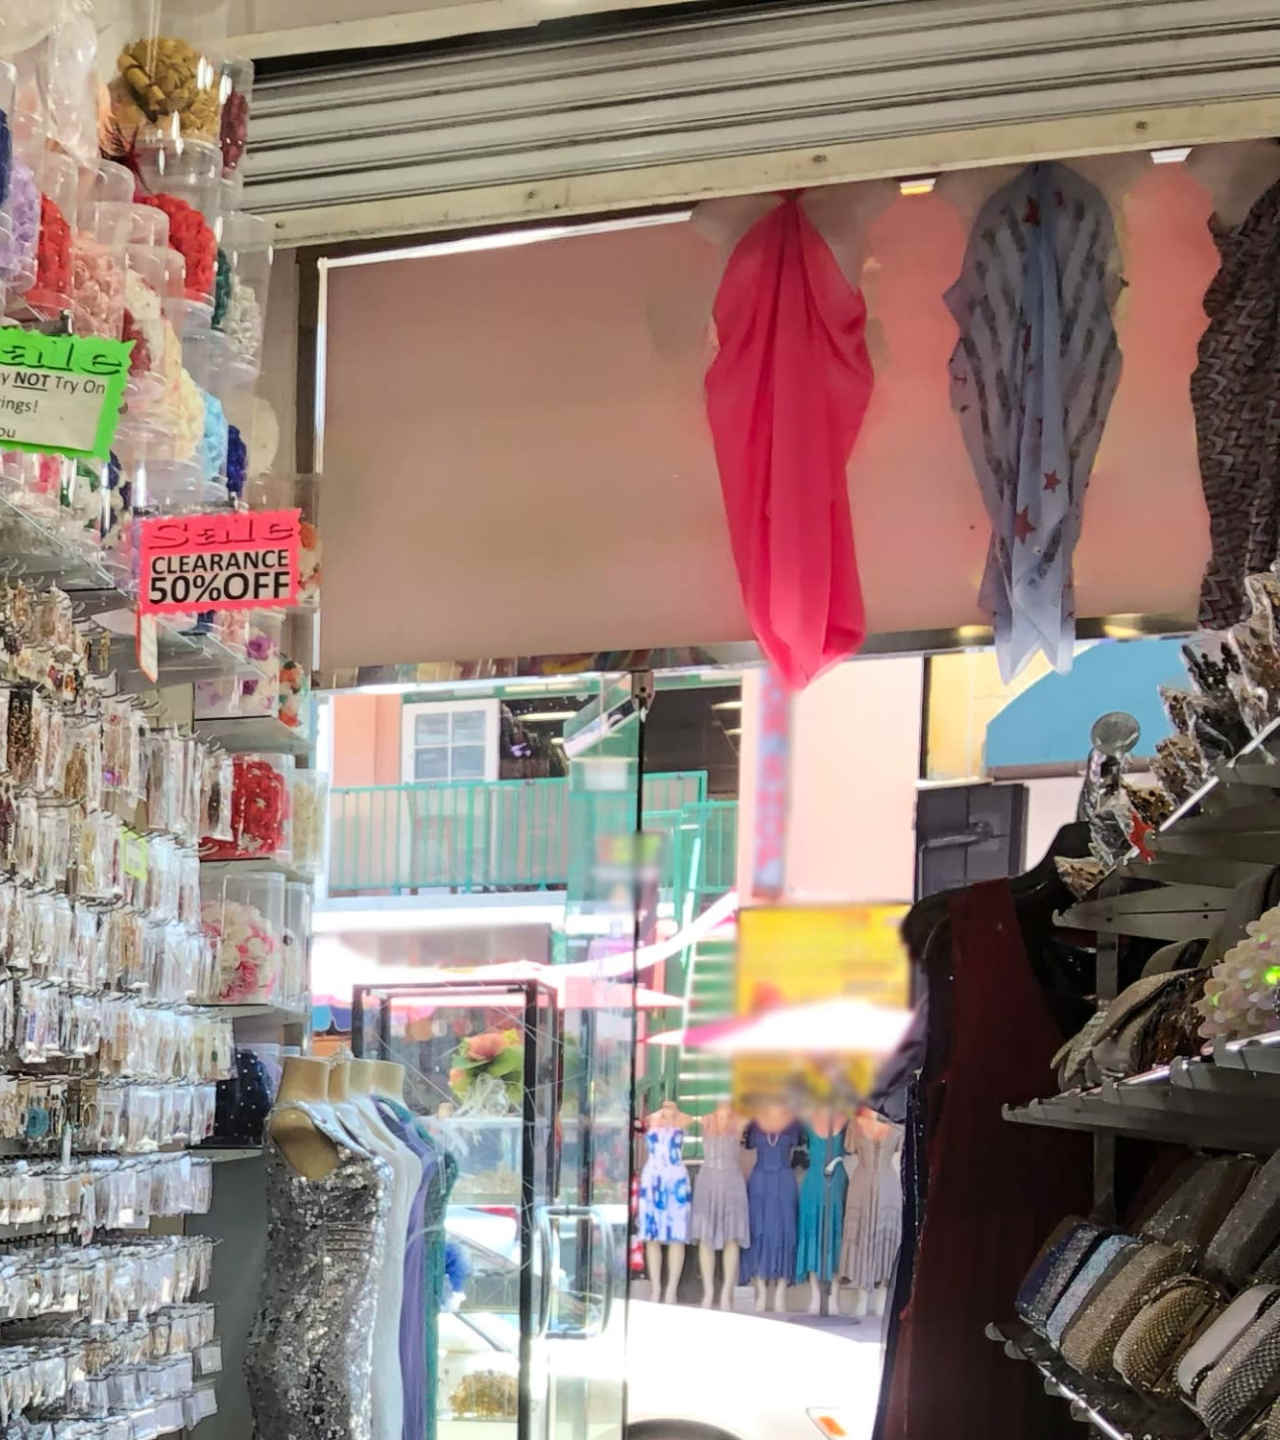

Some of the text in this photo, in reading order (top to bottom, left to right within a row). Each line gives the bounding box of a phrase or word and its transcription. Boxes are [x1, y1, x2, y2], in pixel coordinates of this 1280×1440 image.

[13, 371, 51, 388] NOT
[55, 376, 79, 395] Try
[83, 380, 105, 394] On
[149, 518, 293, 550] Sale
[151, 549, 289, 575] CLEARANCE
[149, 571, 290, 605] 50%OFF
